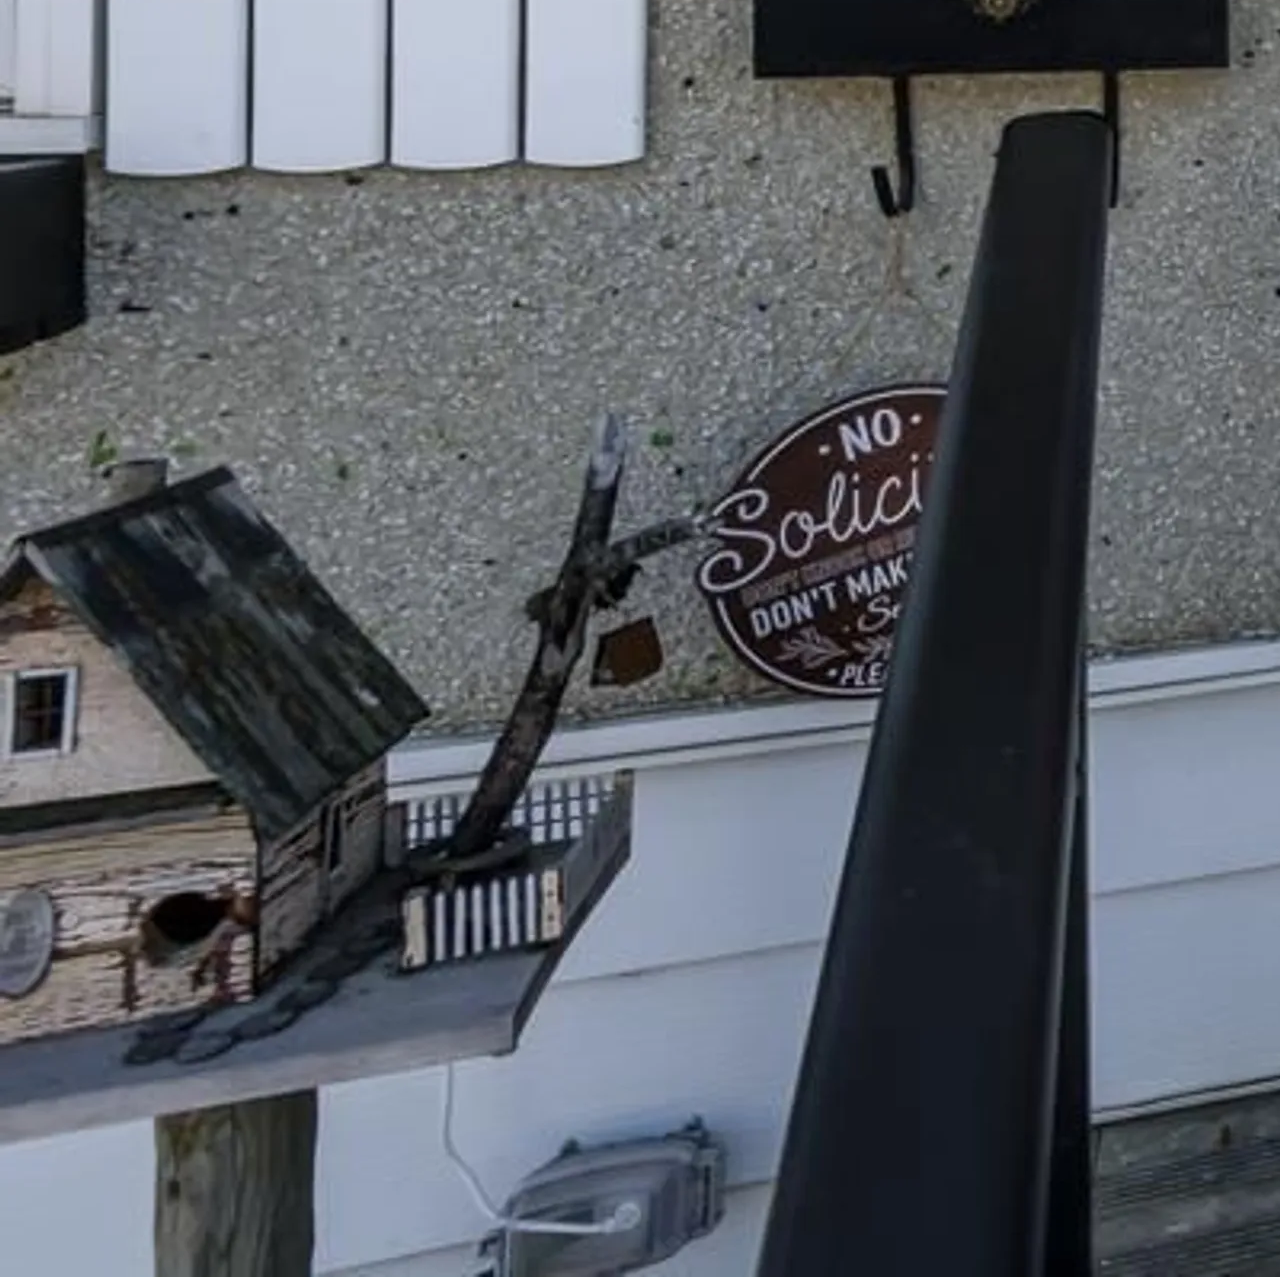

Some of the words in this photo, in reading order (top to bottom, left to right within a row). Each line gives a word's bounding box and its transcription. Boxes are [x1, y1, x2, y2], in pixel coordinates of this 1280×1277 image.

[838, 409, 901, 462] NO
[701, 453, 932, 593] Solici
[750, 580, 838, 639] DON'T
[845, 550, 914, 603] MAK
